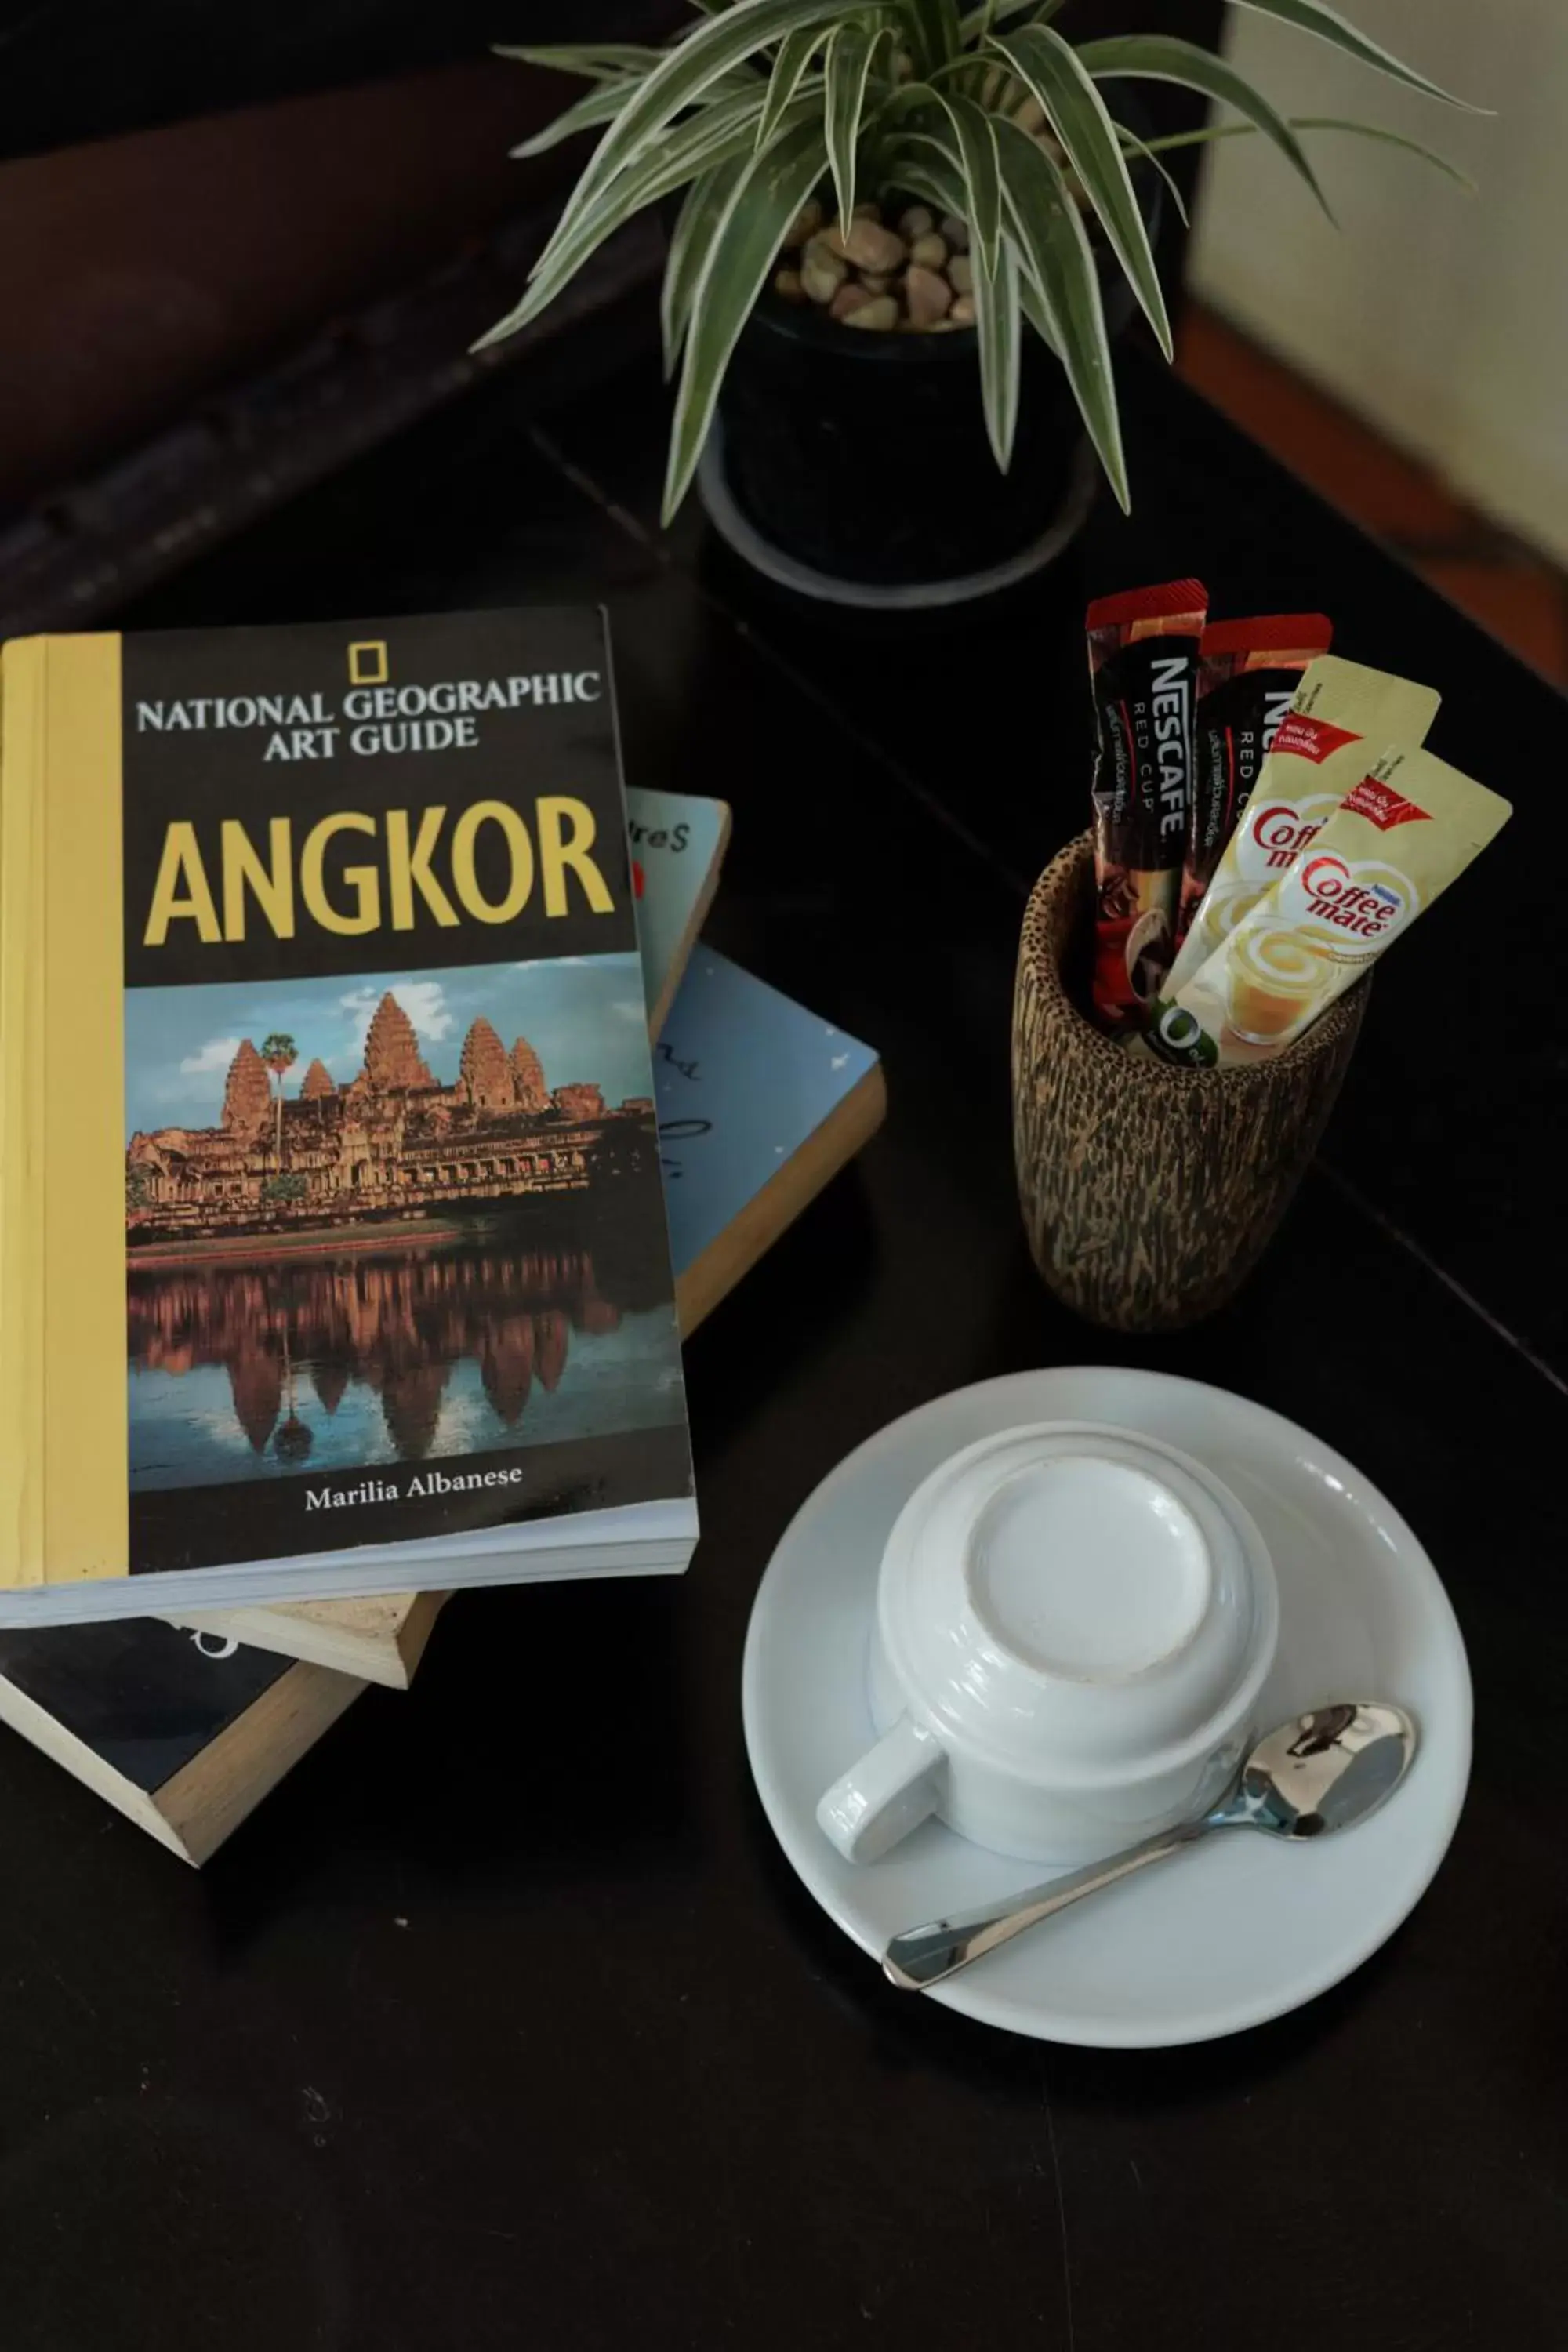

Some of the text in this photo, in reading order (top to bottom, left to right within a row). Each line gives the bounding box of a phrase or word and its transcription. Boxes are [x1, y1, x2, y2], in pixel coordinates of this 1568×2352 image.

[137, 672, 601, 731] NATIONAL GEOGRAPHIC
[263, 717, 480, 762] ART GUIDE
[1134, 701, 1156, 812] RED CUP
[1239, 730, 1255, 779] RED
[143, 796, 615, 946] ANGKOR
[1301, 856, 1396, 920] Coffee
[1305, 896, 1383, 938] mate
[305, 1468, 524, 1511] Marilia Albanese
